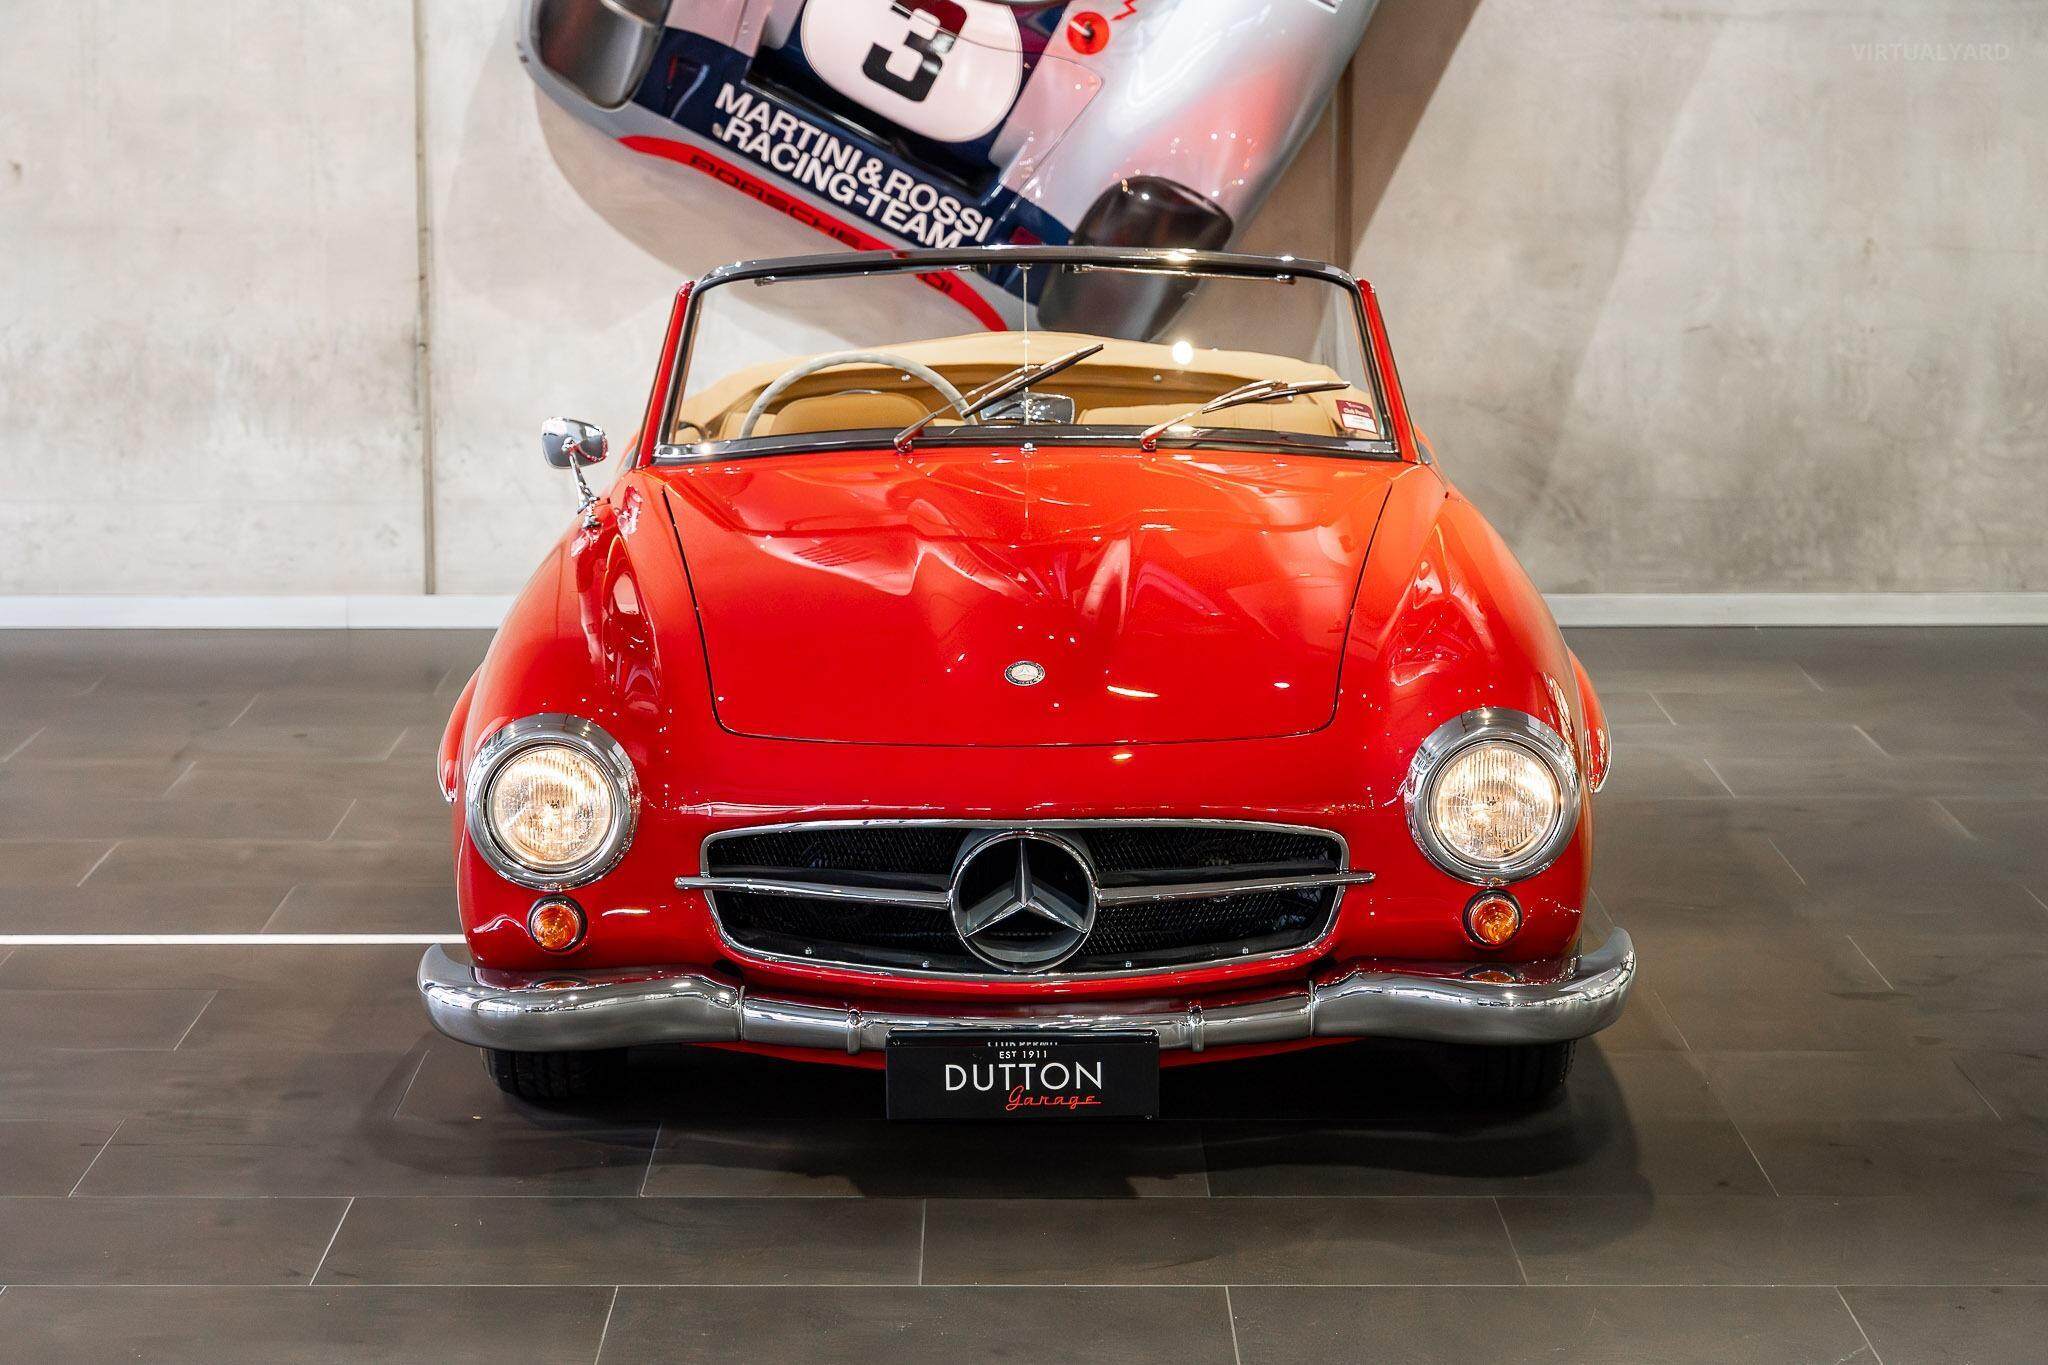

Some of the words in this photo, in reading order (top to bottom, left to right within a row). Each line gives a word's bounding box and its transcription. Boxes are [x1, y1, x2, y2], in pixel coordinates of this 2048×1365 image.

[862, 0, 967, 103] 3
[999, 1050, 1017, 1059] EST
[1022, 1050, 1047, 1059] 1911
[945, 1062, 1102, 1091] DUTTON
[1005, 1085, 1102, 1111] Garage
